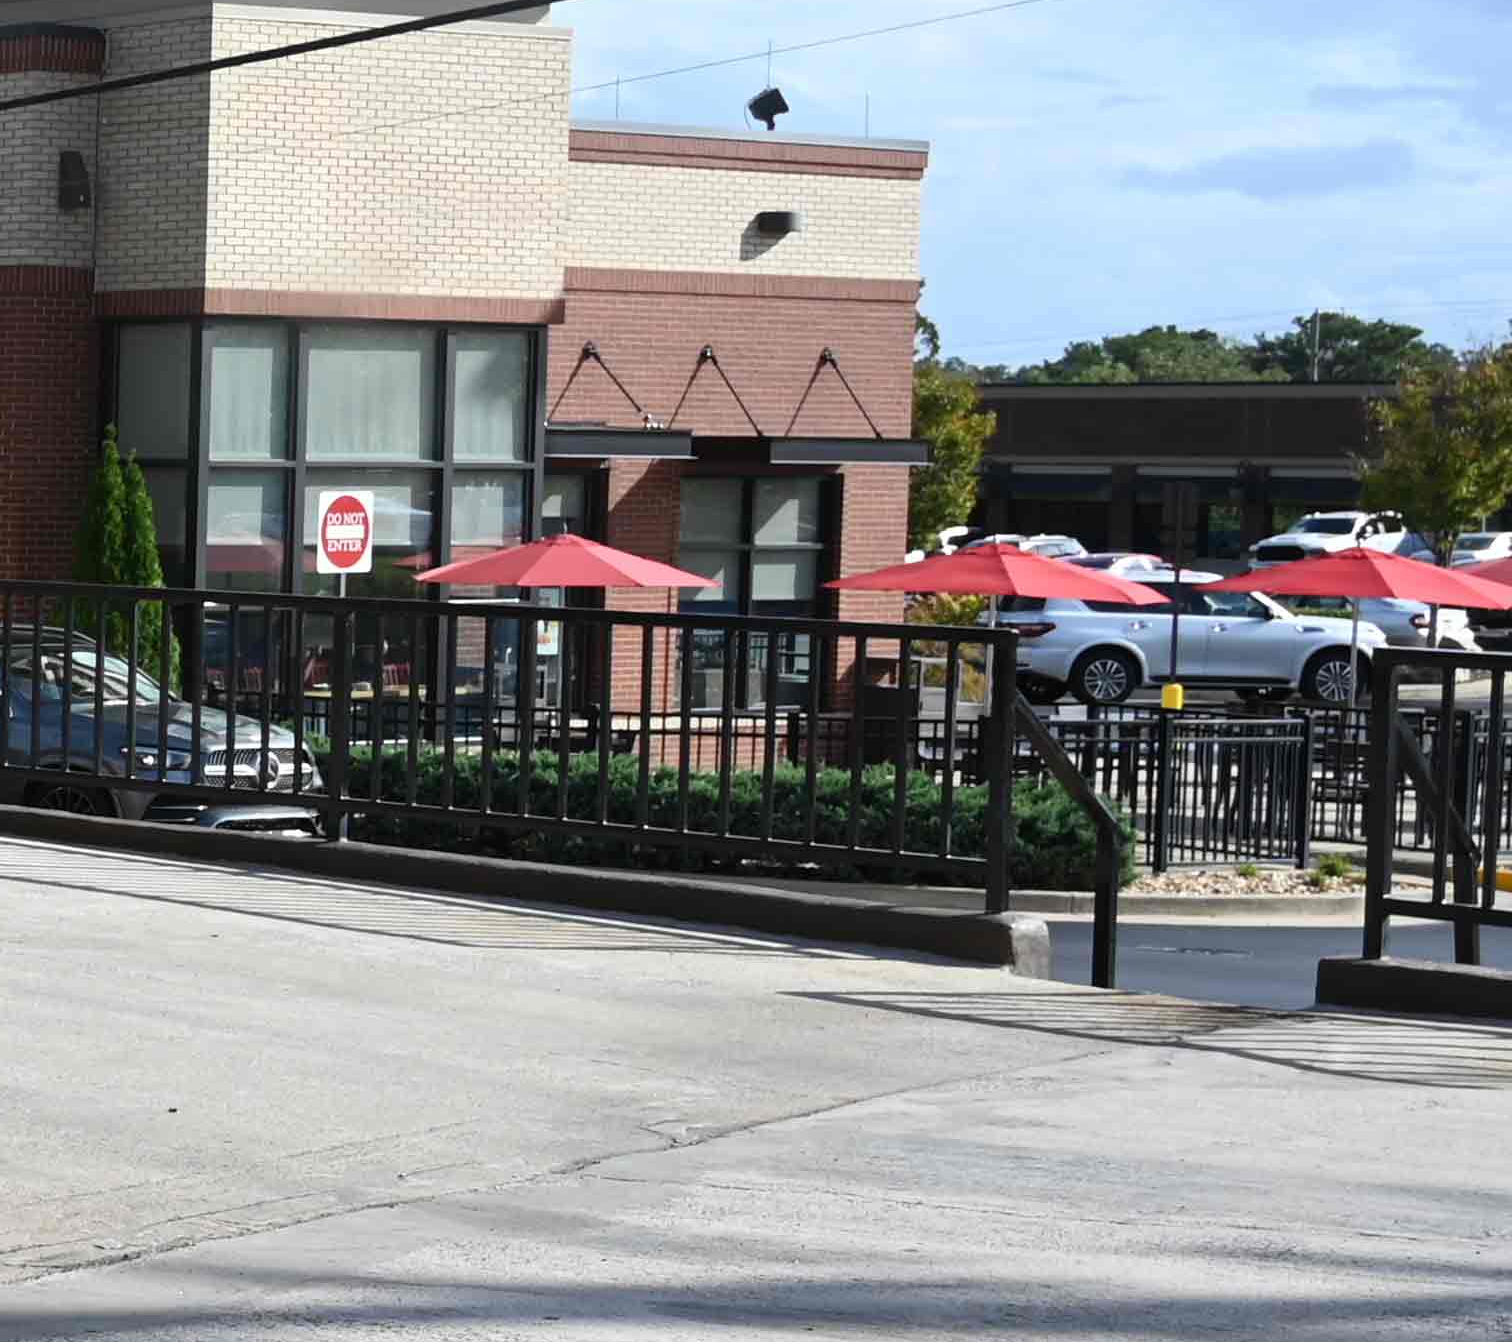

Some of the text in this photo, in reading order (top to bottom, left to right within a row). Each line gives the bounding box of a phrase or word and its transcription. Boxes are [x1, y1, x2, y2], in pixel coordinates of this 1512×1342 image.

[326, 512, 366, 525] DO NOT
[327, 539, 363, 552] ENTER
